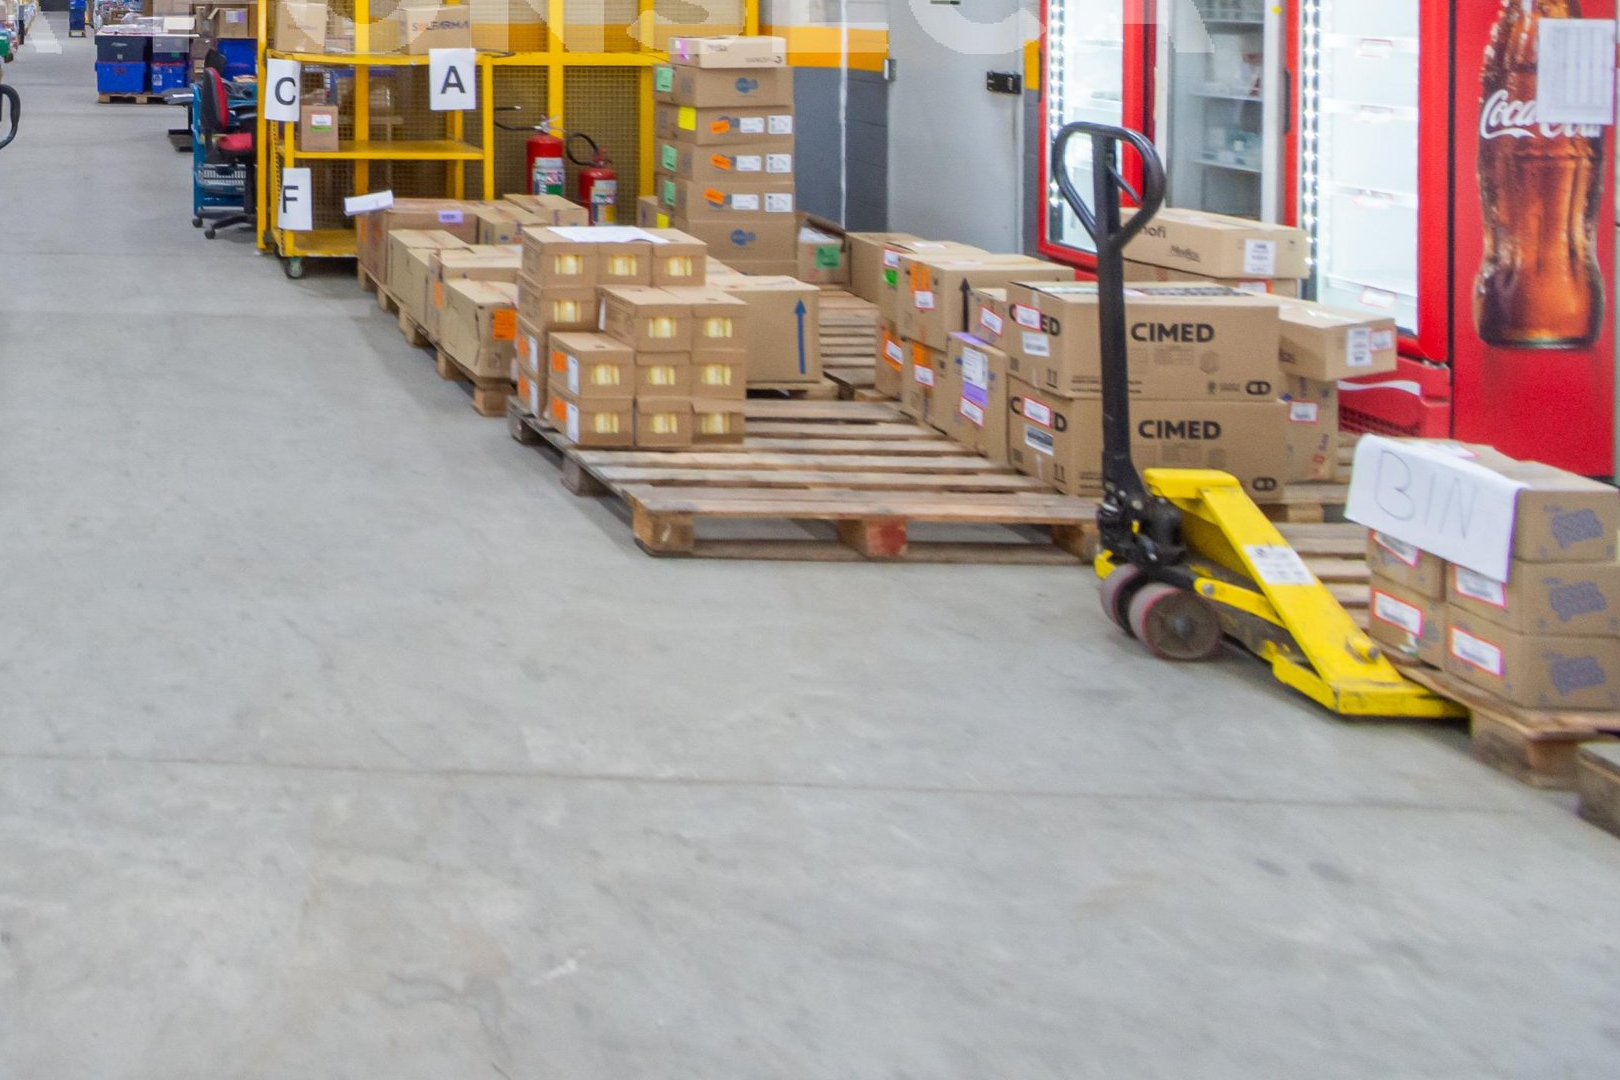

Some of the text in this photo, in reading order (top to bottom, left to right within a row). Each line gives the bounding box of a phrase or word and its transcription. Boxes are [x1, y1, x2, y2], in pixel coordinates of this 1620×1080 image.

[274, 77, 297, 106] C
[440, 65, 467, 95] A
[282, 185, 299, 214] F
[1131, 323, 1215, 343] CIMED
[1138, 419, 1221, 441] CIMED
[1374, 450, 1478, 540] BIN
